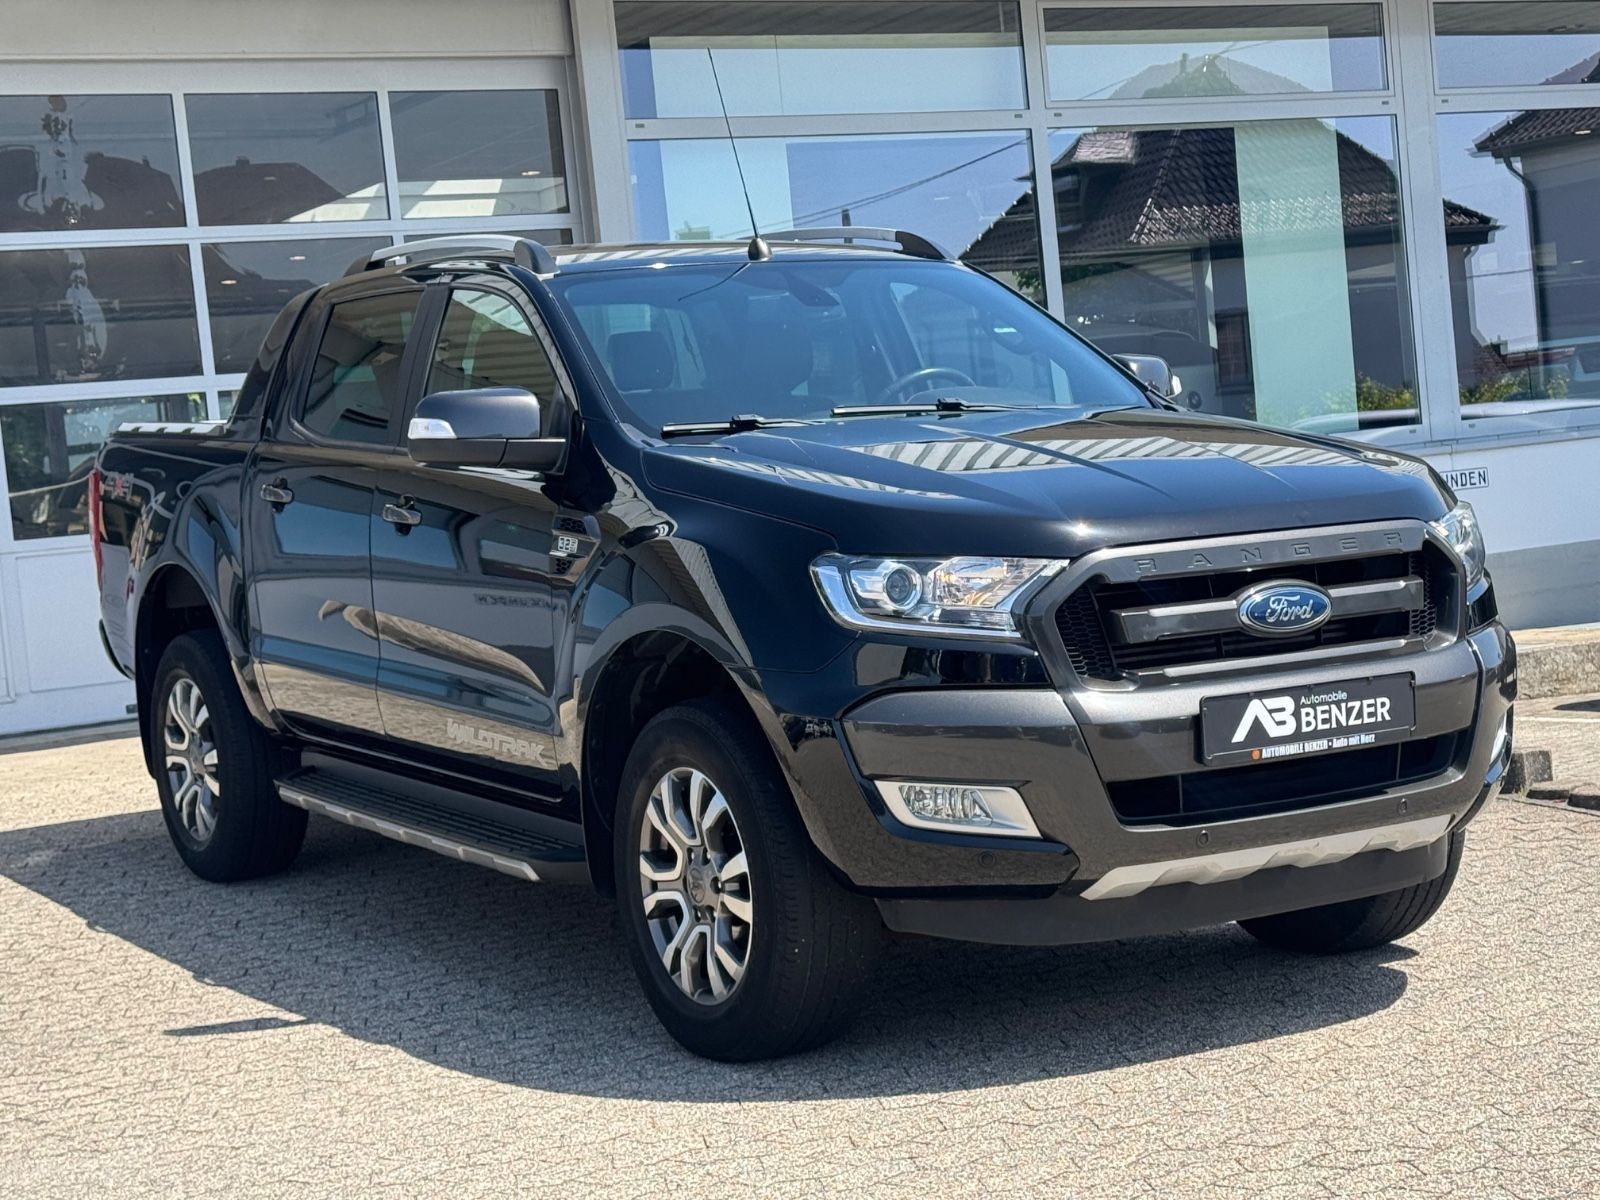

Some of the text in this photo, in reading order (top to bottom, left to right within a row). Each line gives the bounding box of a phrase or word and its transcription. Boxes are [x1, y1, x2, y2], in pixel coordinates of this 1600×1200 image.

[1135, 532, 1403, 573] RANGER
[1266, 595, 1314, 622] Ford
[1300, 691, 1347, 705] Automobile
[1300, 698, 1391, 733] BENZER
[447, 718, 548, 767] WILDTRAK
[1262, 743, 1304, 758] AUTOMOBILE
[1304, 739, 1328, 752] BENZER
[1332, 738, 1348, 748] Auto
